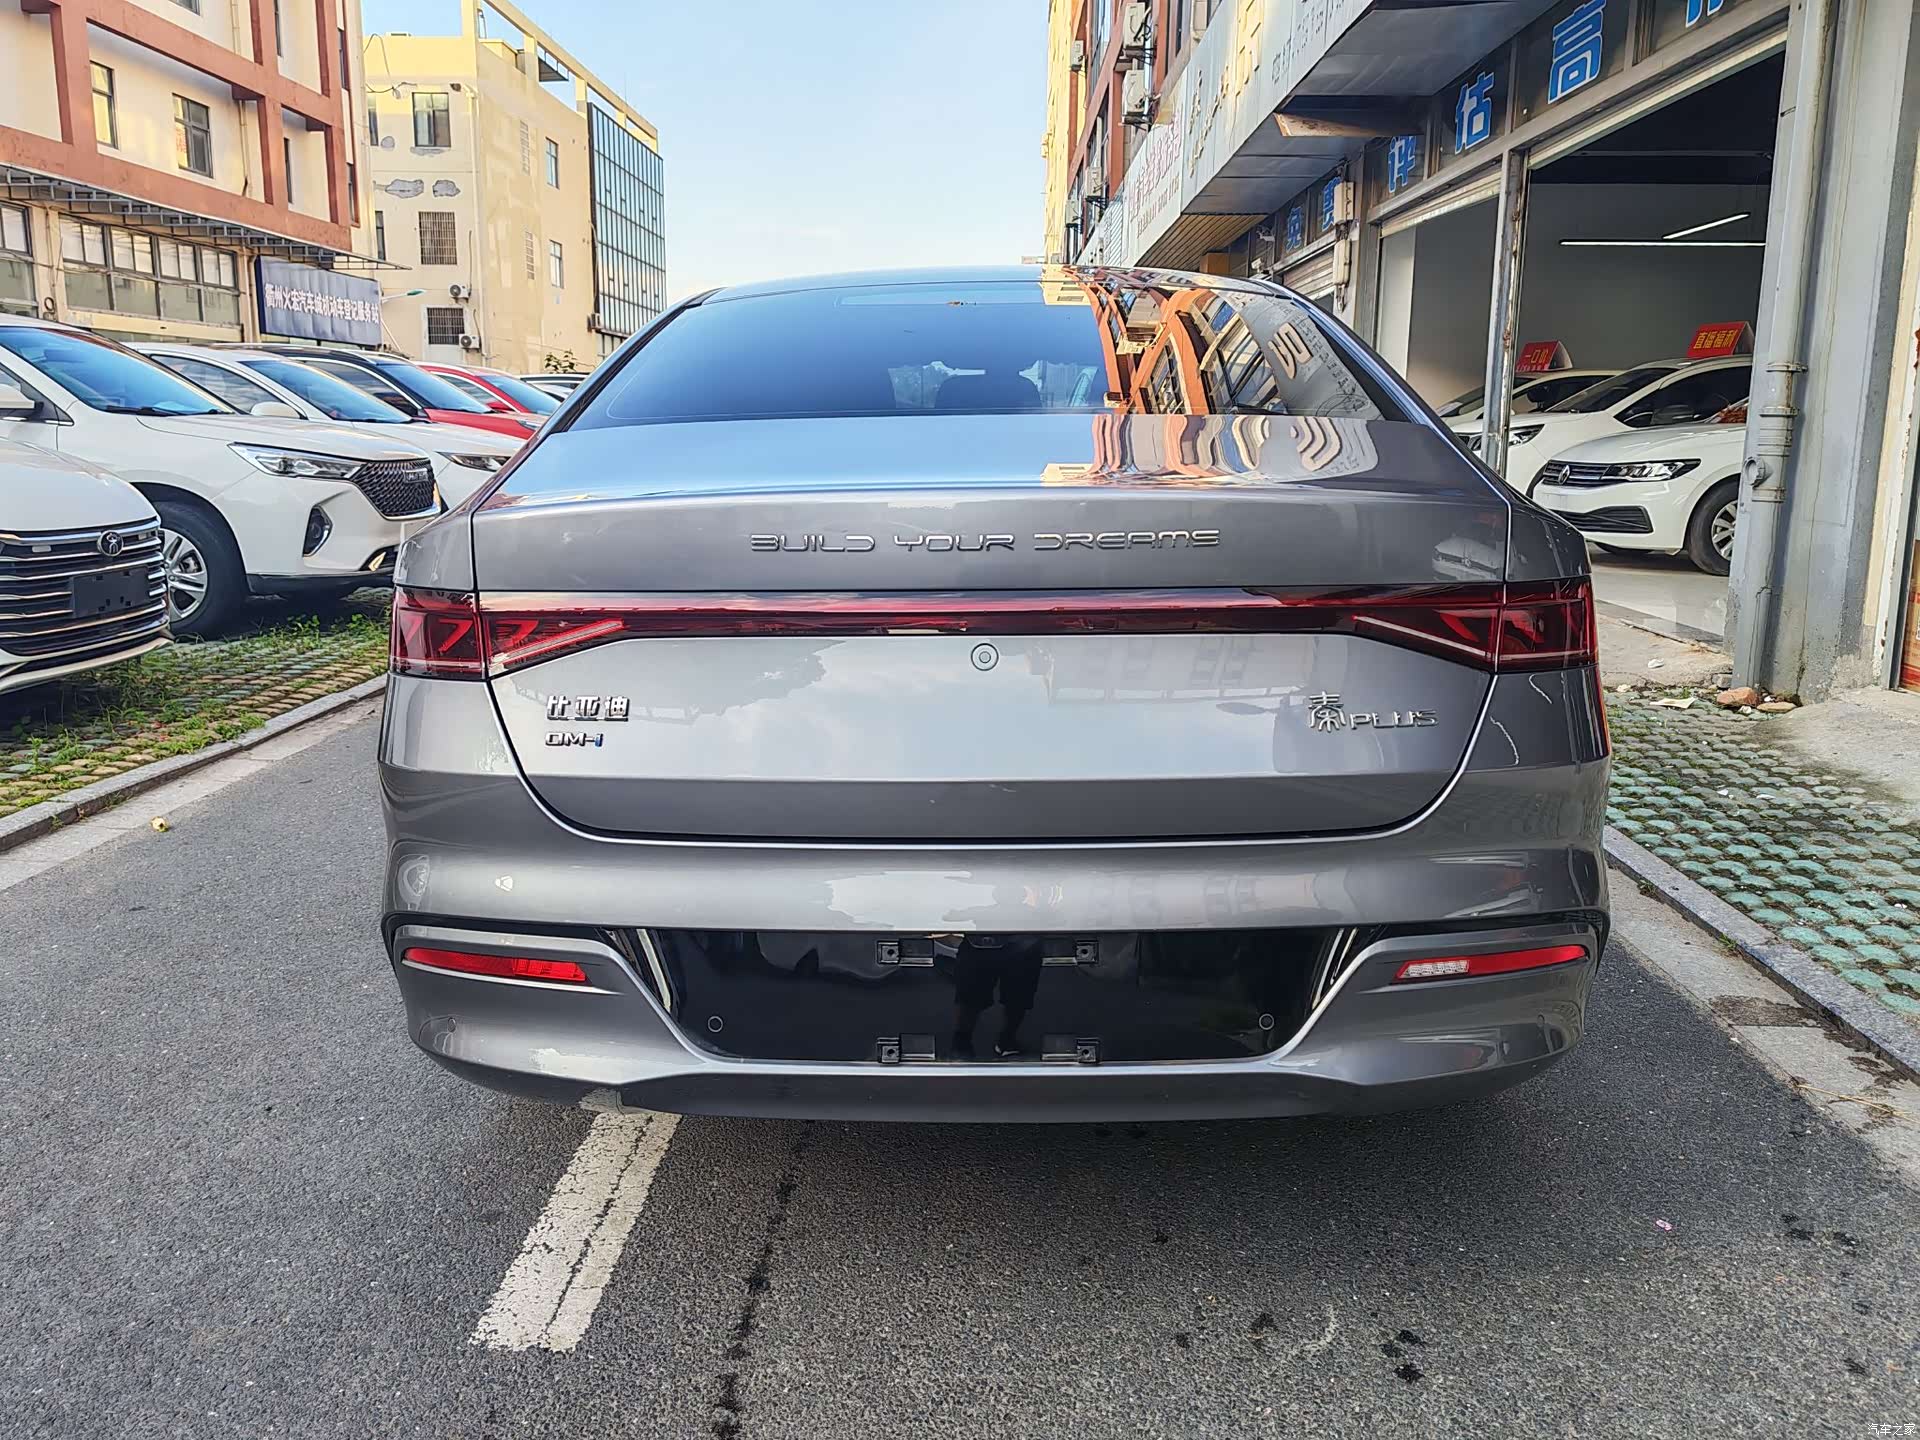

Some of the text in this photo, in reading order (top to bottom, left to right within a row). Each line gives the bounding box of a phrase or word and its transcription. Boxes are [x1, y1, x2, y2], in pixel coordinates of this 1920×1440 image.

[1693, 328, 1739, 350] 直播福利
[750, 528, 1221, 553] BUILD YOUR DREAMS
[546, 695, 630, 721] 比亚迪
